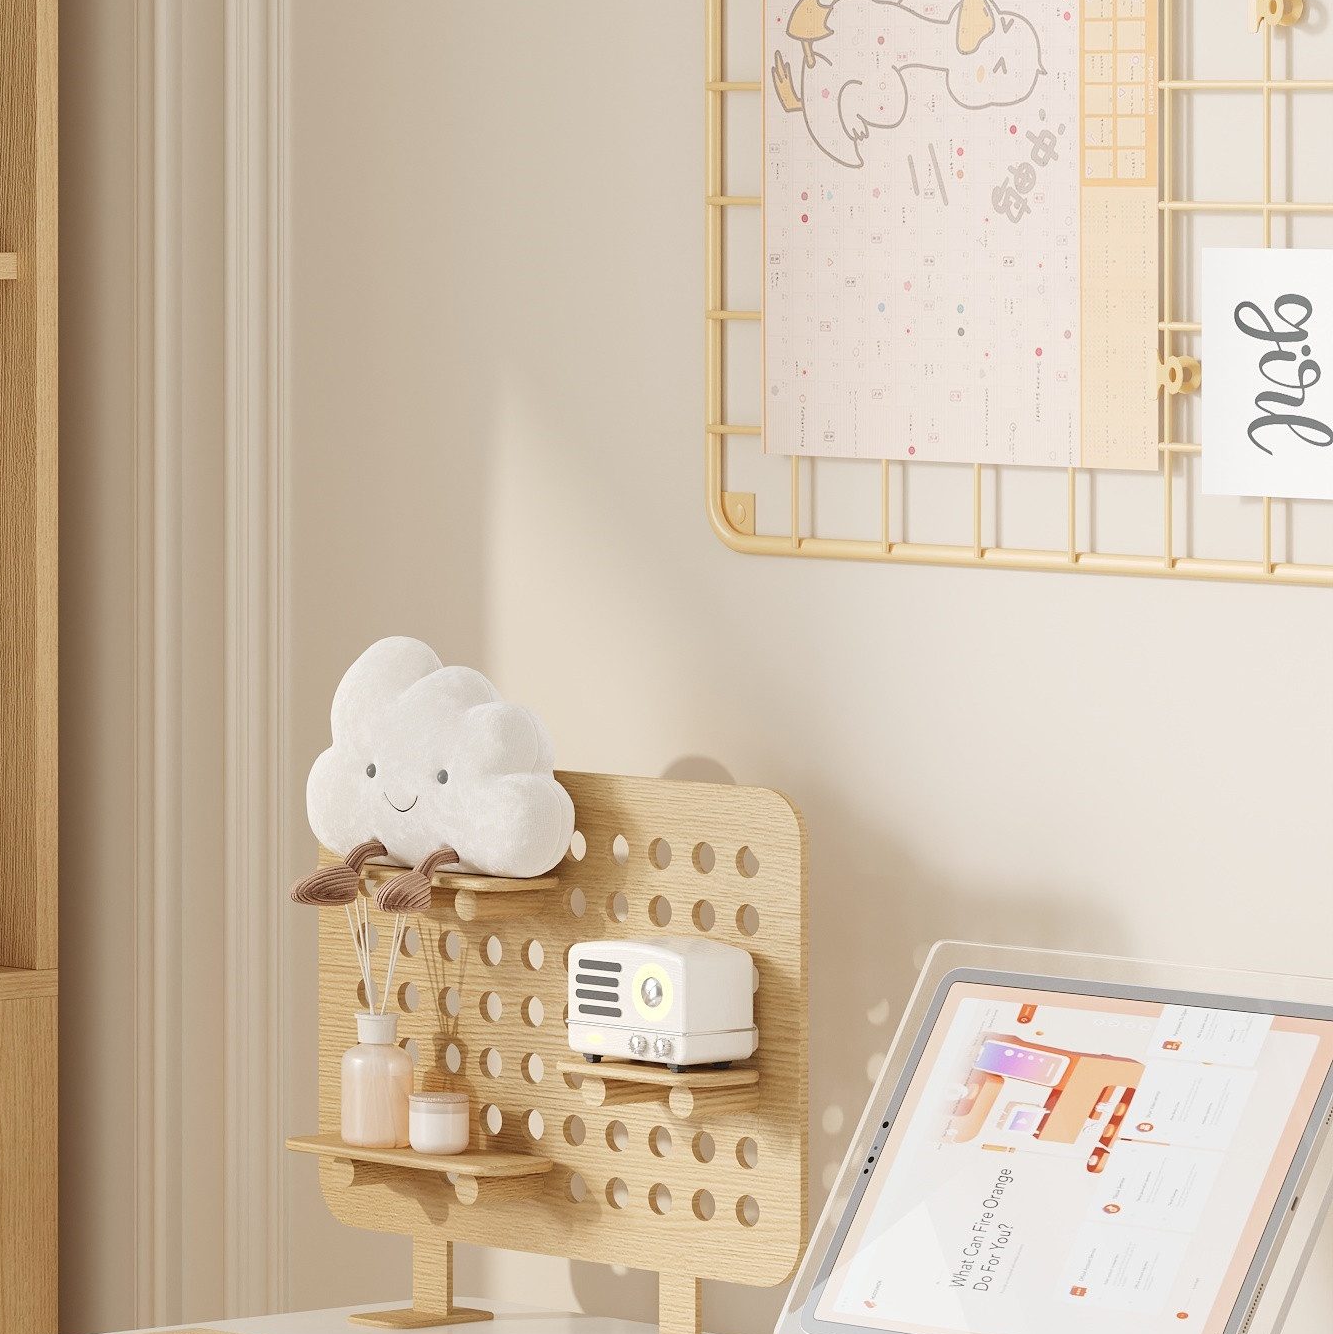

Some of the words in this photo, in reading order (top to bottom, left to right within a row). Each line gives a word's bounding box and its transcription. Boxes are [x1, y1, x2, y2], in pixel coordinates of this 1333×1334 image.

[1234, 293, 1333, 456] girl
[982, 1168, 1013, 1208] Orange
[972, 1212, 994, 1232] Fire
[963, 1236, 984, 1256] Can
[989, 1223, 1013, 1250] You?
[949, 1260, 974, 1287] What
[981, 1254, 1001, 1273] For
[973, 1275, 992, 1291] Do
